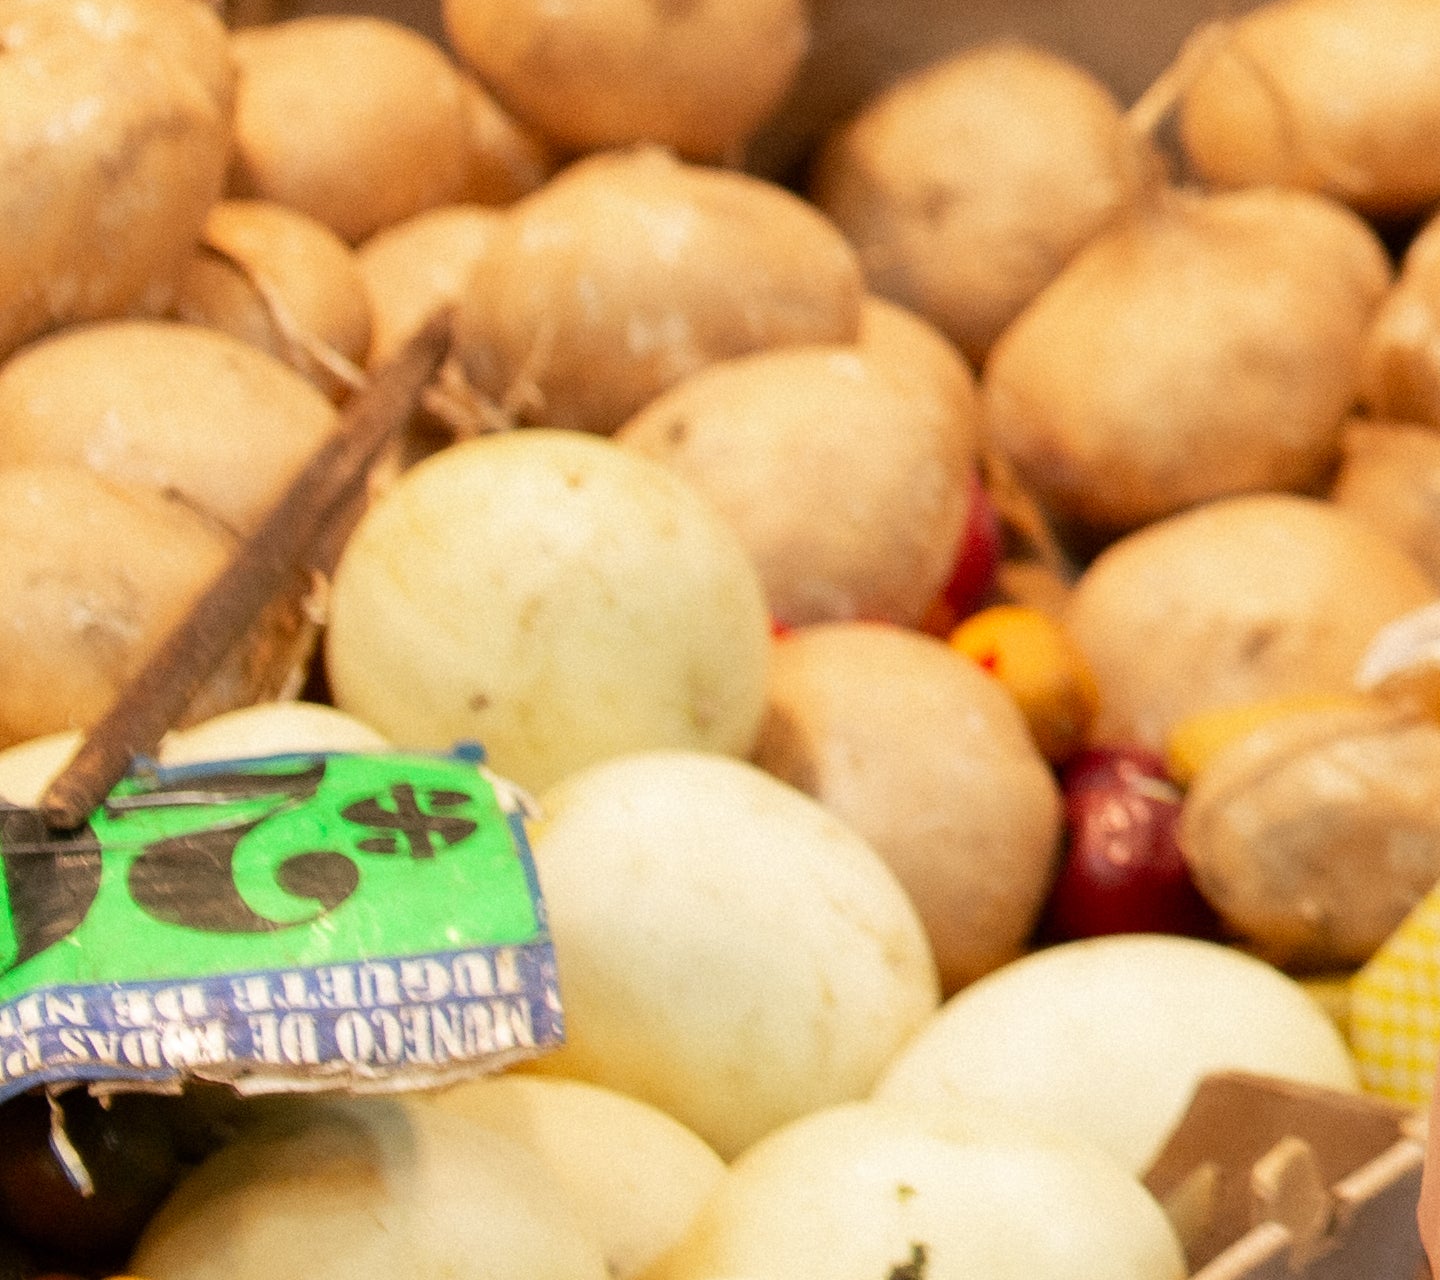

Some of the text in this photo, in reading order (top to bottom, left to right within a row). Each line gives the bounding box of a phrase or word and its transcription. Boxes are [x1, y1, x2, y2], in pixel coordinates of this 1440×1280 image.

[110, 983, 208, 1028] DE
[230, 946, 523, 1014] JUGUETE
[247, 1010, 321, 1065] DE
